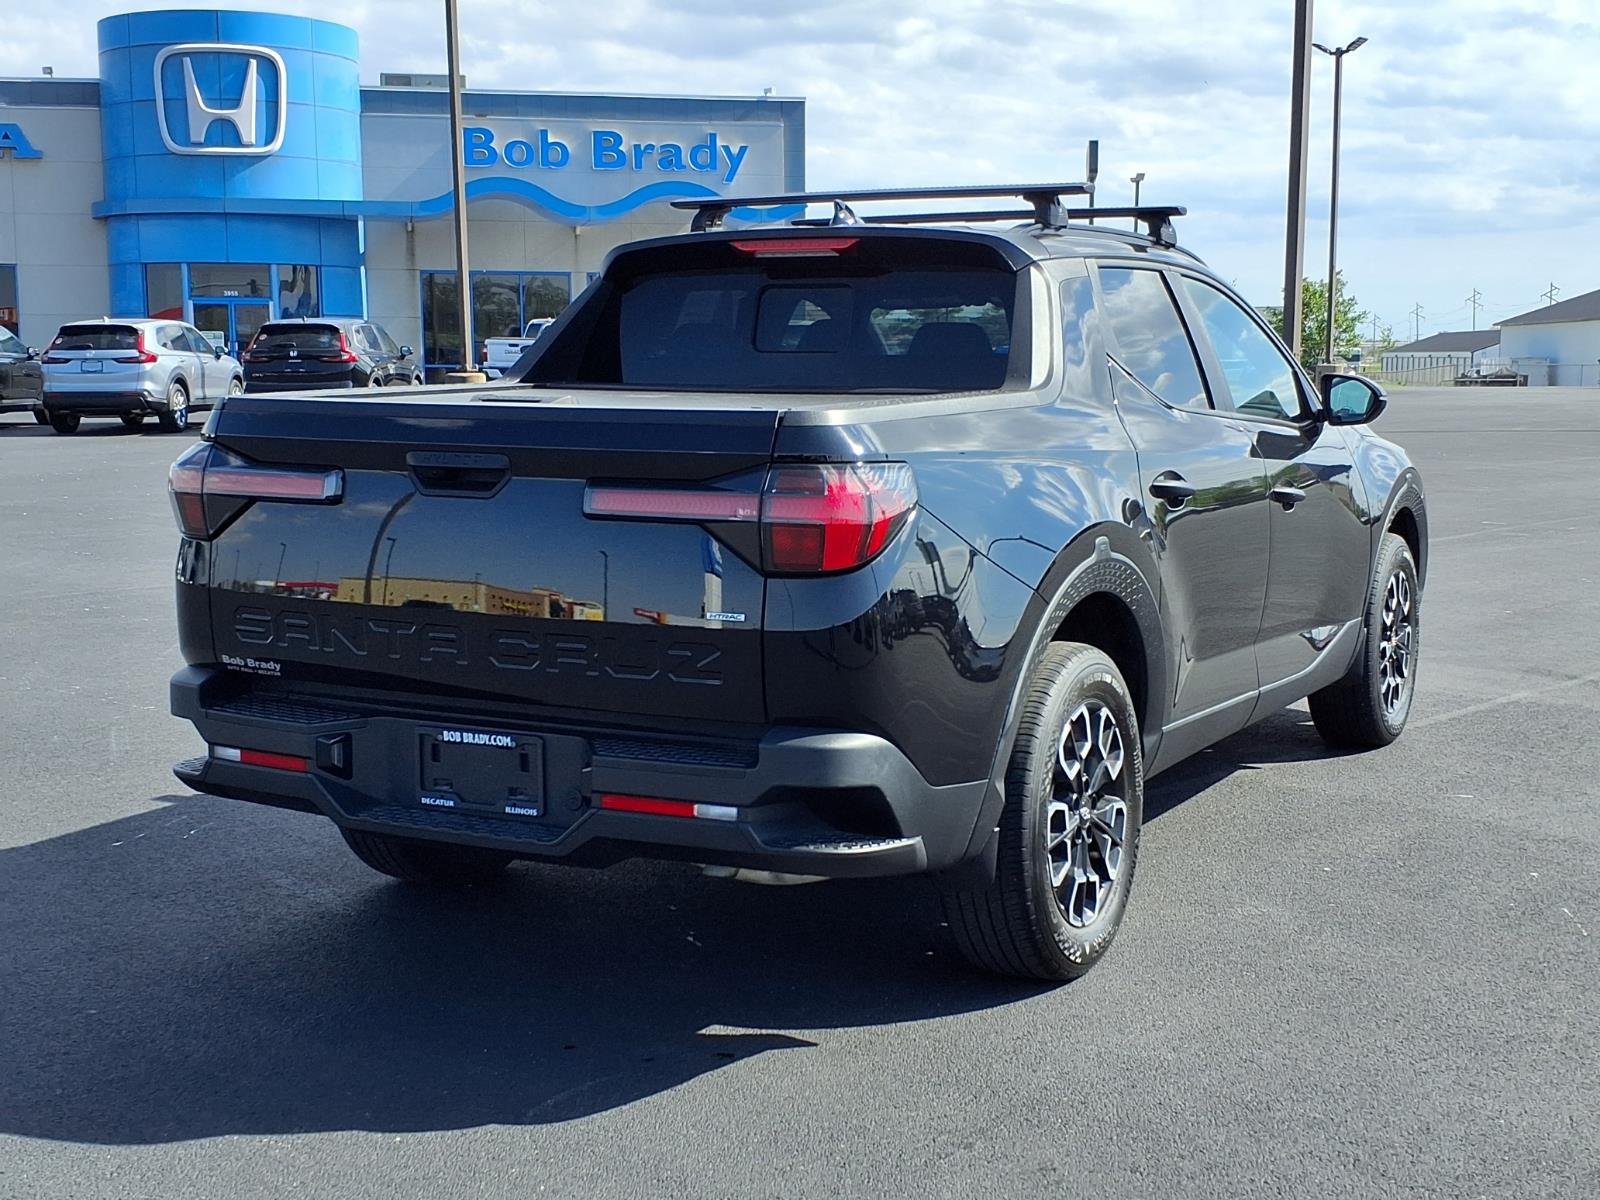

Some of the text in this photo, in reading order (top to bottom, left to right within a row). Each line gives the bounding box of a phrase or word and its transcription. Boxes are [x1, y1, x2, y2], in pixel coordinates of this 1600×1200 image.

[462, 127, 749, 184] Bob Brady
[233, 605, 724, 686] SANTA CRUZ
[221, 654, 281, 672] Bob Brady
[442, 730, 512, 747] BOB BRADY.COM
[421, 797, 538, 817] DECATUR ILLINOIS
